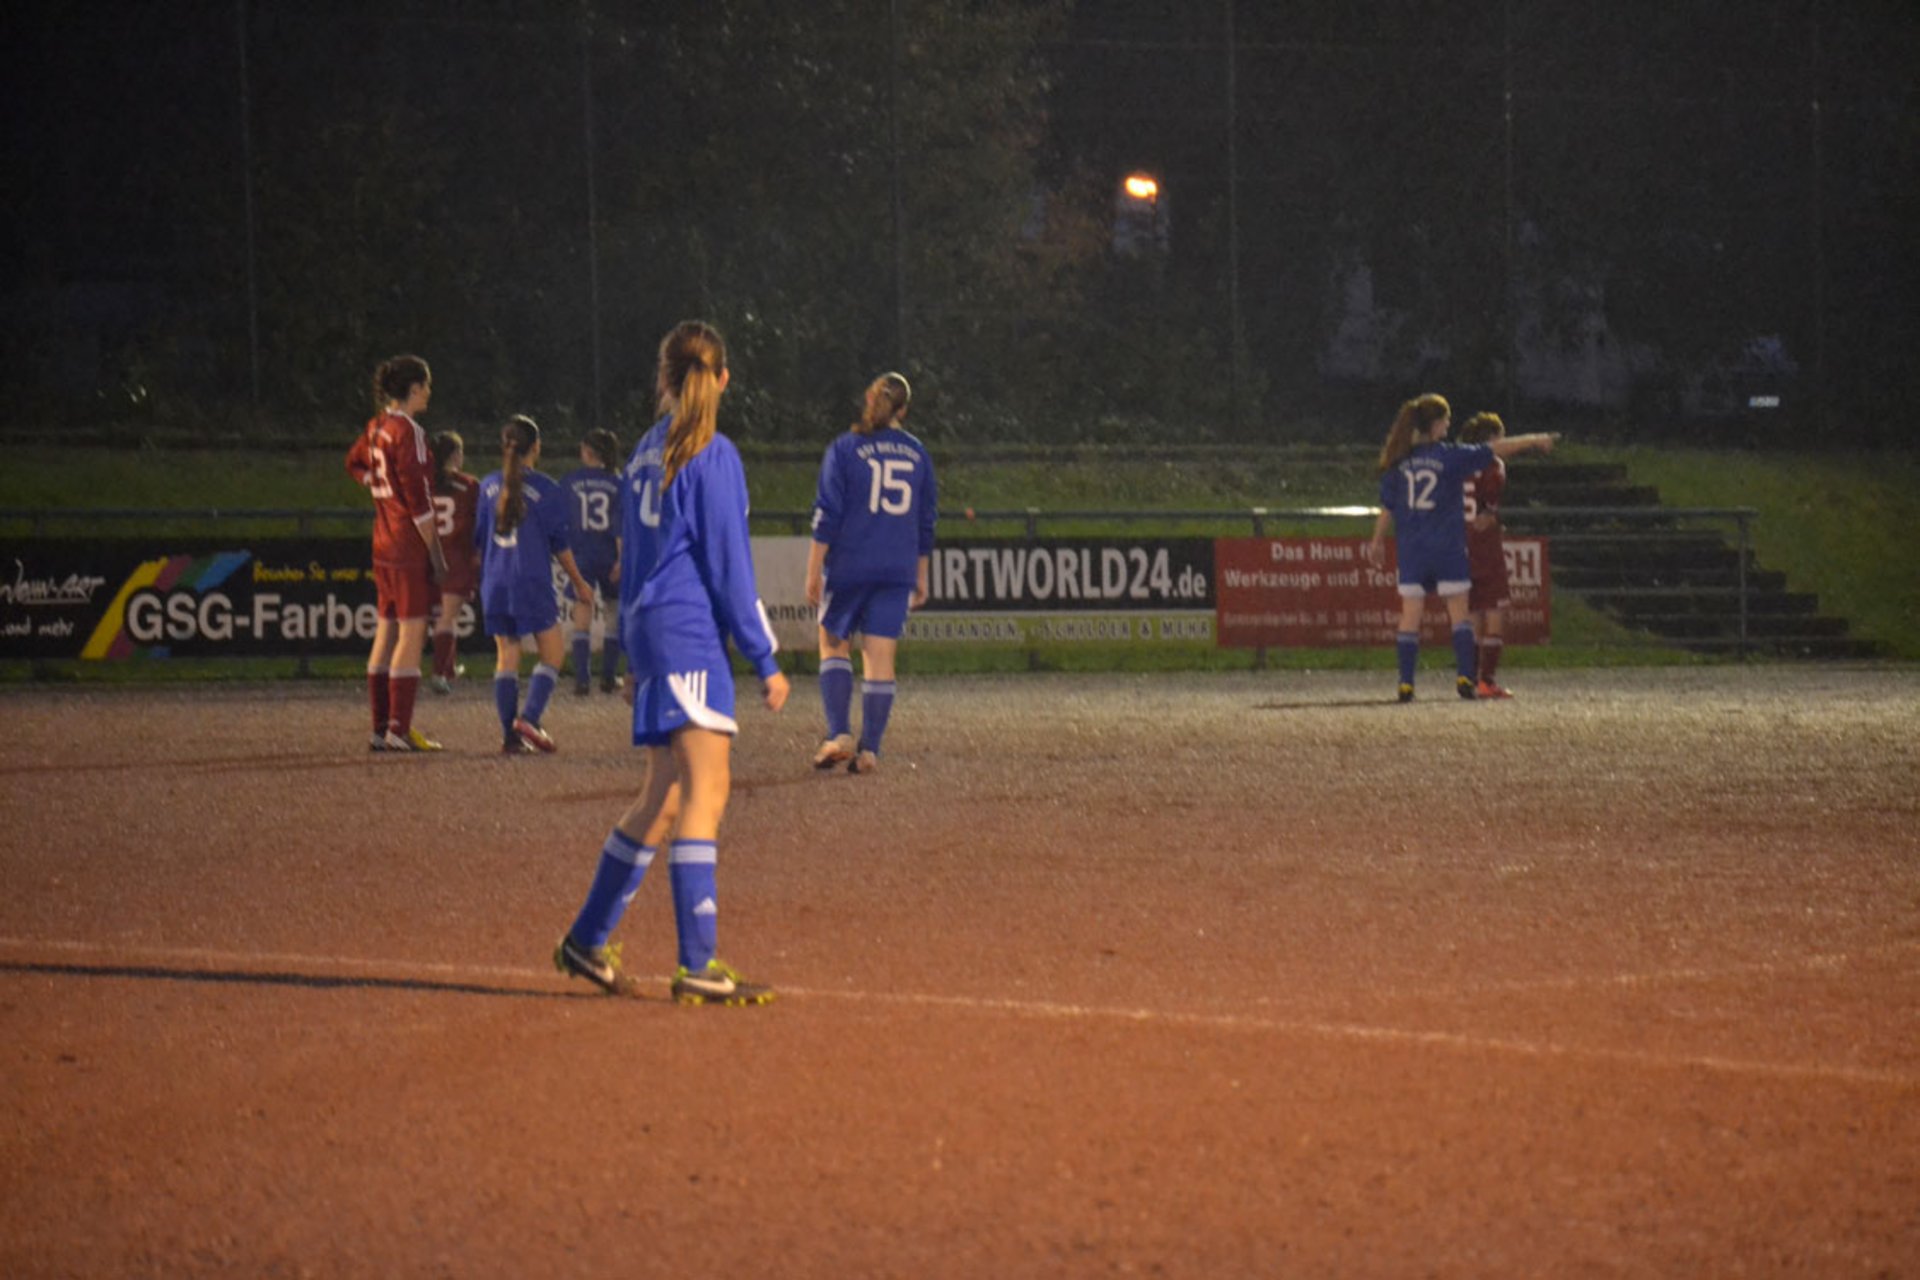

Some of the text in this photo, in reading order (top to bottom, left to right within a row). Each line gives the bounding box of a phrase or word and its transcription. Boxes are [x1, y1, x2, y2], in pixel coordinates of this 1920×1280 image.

[867, 457, 914, 515] 15
[1405, 469, 1437, 509] 12
[579, 491, 609, 530] 13
[1272, 542, 1304, 560] Das
[1310, 543, 1353, 560] Haus
[1224, 568, 1321, 589] Werkzeuge
[1327, 568, 1359, 587] und
